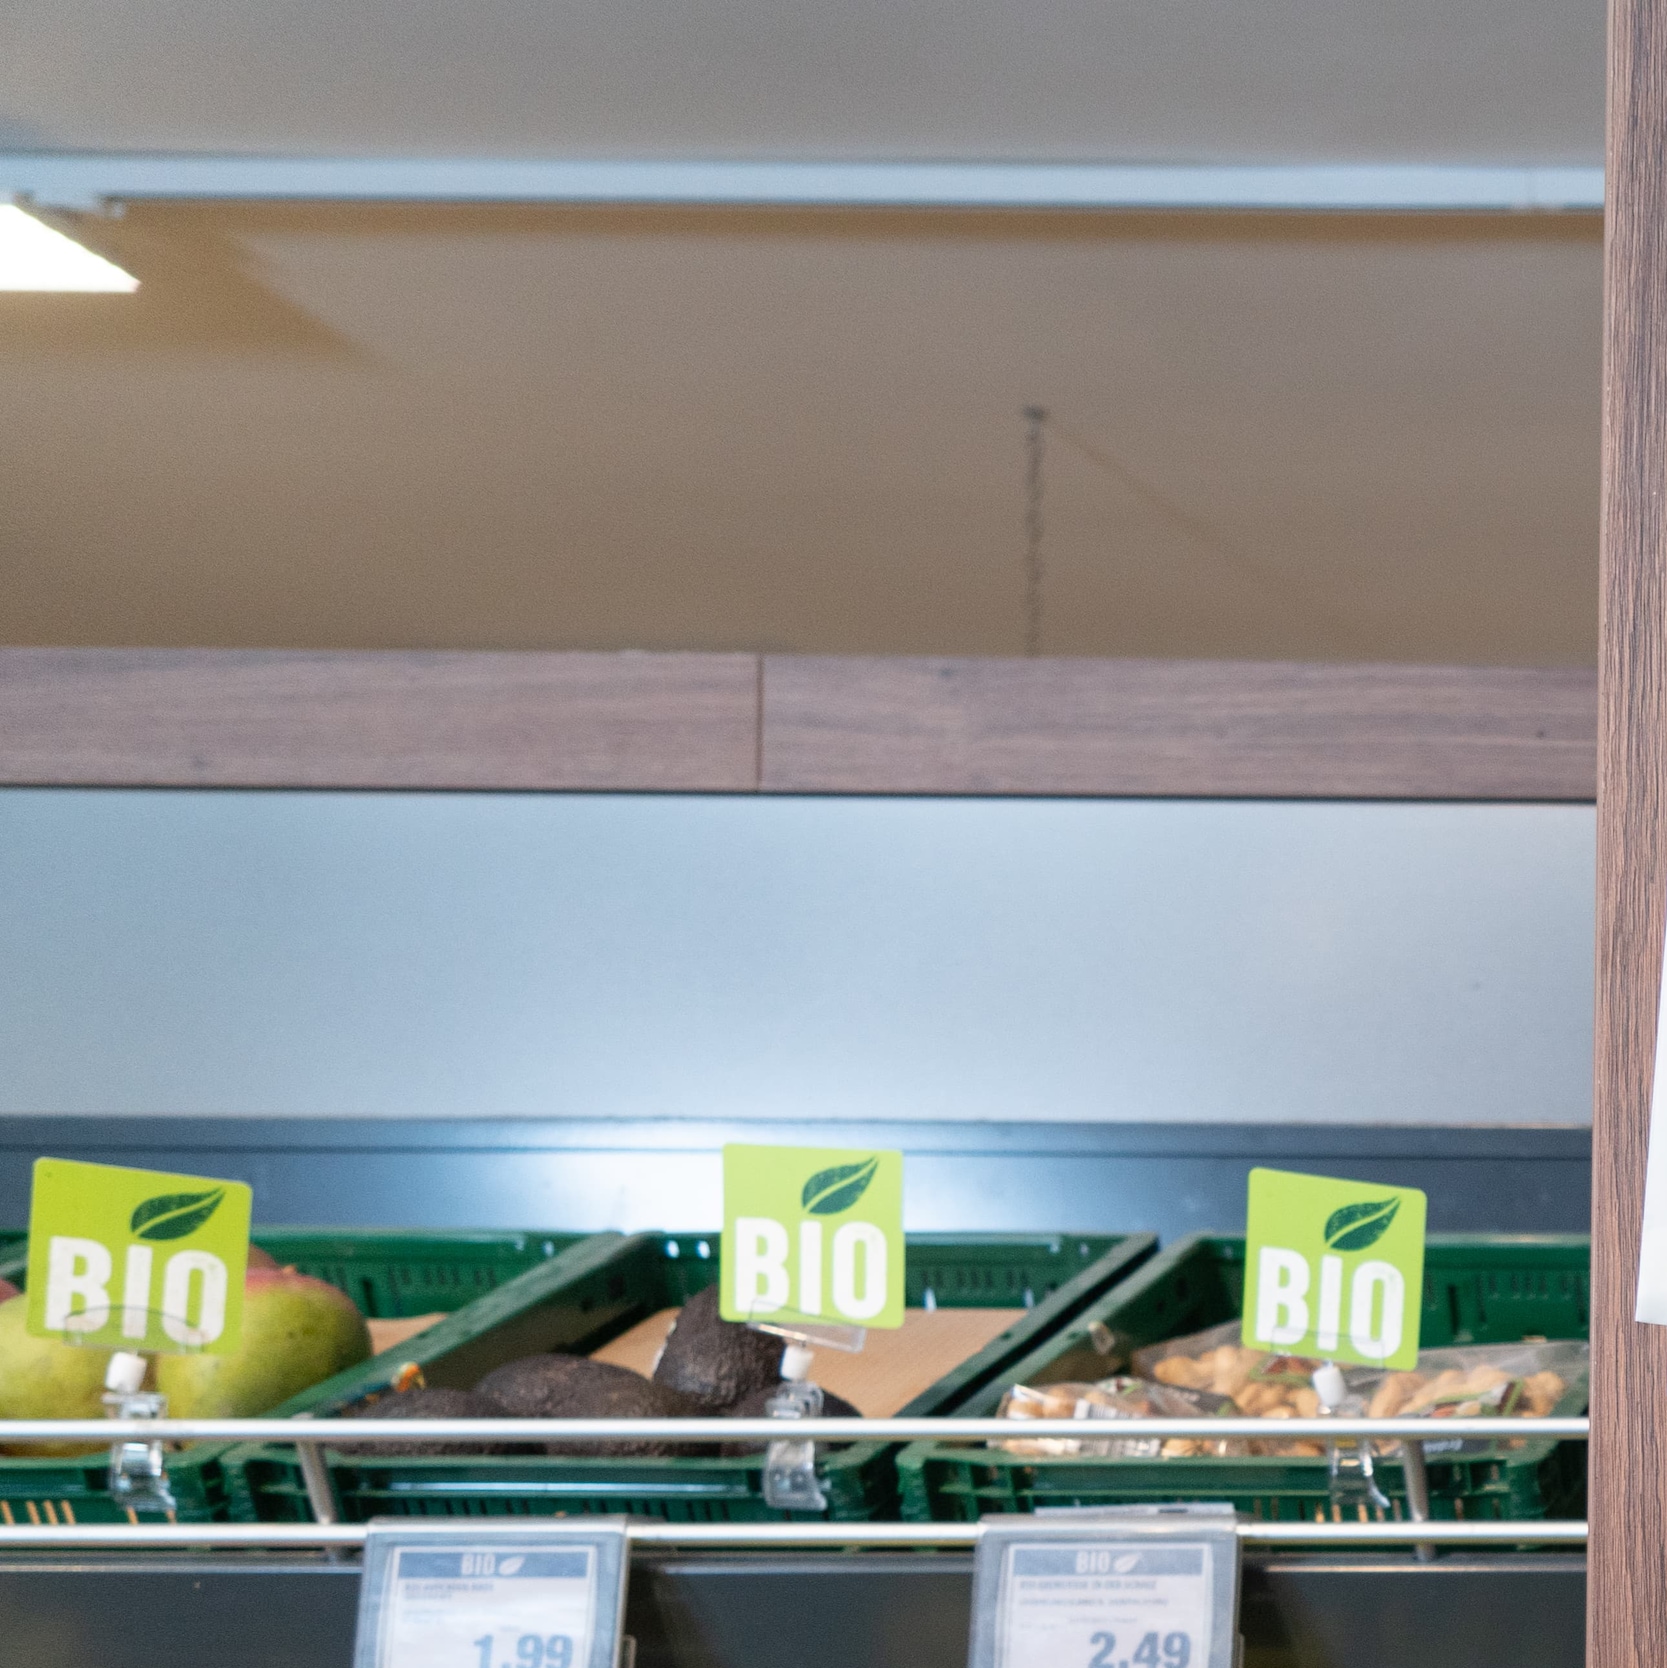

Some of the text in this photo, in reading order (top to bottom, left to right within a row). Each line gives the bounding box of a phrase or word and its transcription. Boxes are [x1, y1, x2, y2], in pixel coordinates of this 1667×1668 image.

[44, 1236, 229, 1346] BIO
[735, 1217, 888, 1320] BIO
[1256, 1246, 1406, 1359] BIO
[461, 1552, 497, 1576] BIO
[1075, 1550, 1112, 1575] BIO
